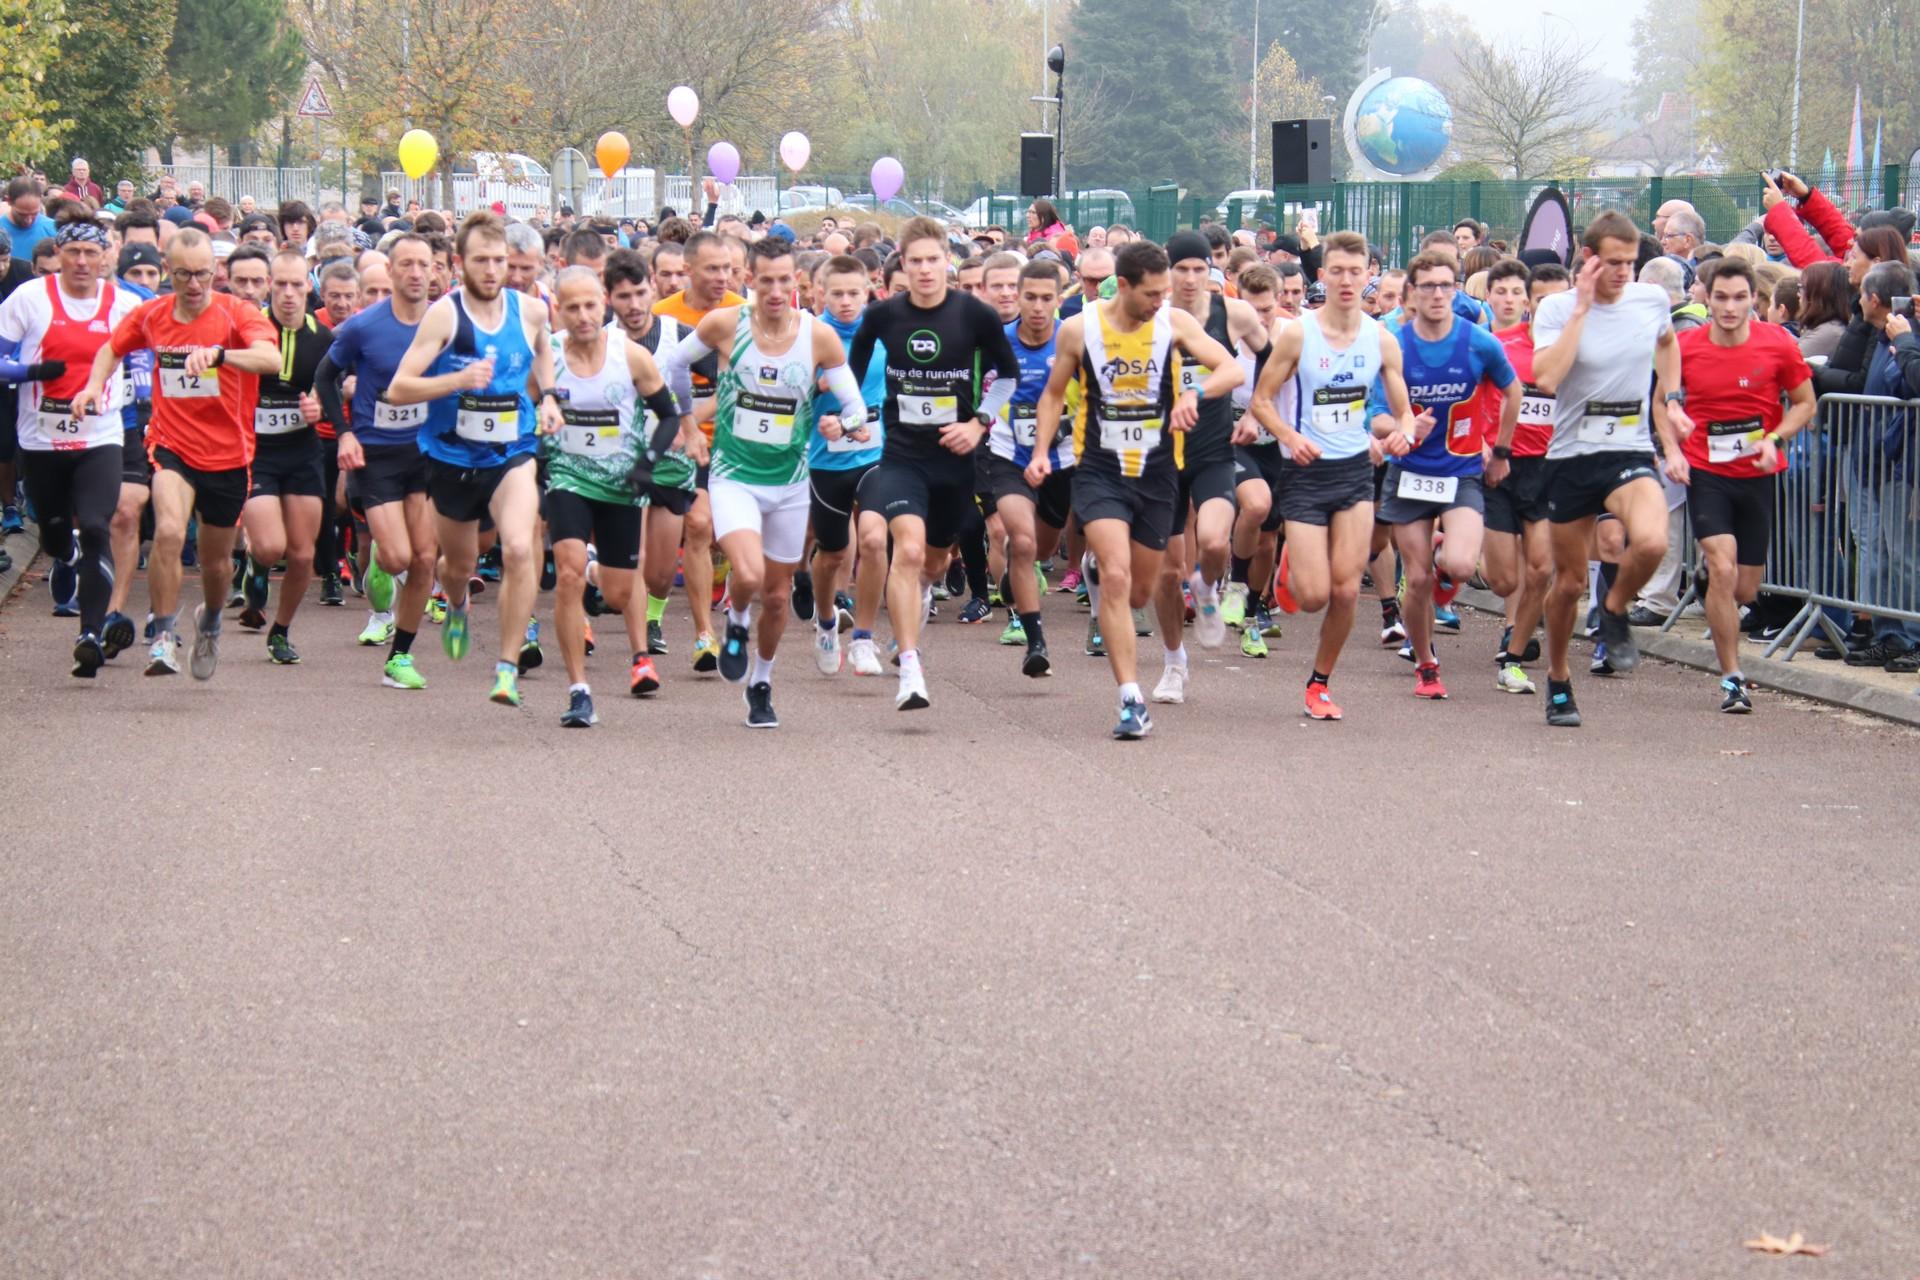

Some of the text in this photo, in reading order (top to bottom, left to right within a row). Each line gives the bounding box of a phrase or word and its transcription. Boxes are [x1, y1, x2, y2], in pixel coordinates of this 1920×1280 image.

[908, 368, 922, 378] de
[926, 368, 970, 381] running
[1183, 372, 1192, 385] 8
[177, 376, 200, 389] 12
[1410, 382, 1468, 397] DIJON
[388, 408, 418, 421] 321
[921, 402, 932, 416] 6
[1331, 409, 1350, 423] 11
[1521, 402, 1551, 416] 249
[56, 420, 79, 433] 45
[268, 413, 300, 426] 319
[484, 418, 495, 432] 9
[758, 419, 769, 433] 5
[1121, 427, 1143, 441] 10
[1605, 422, 1615, 435] 3
[585, 433, 595, 446] 2
[1733, 439, 1743, 453] 4
[1413, 479, 1445, 494] 338
